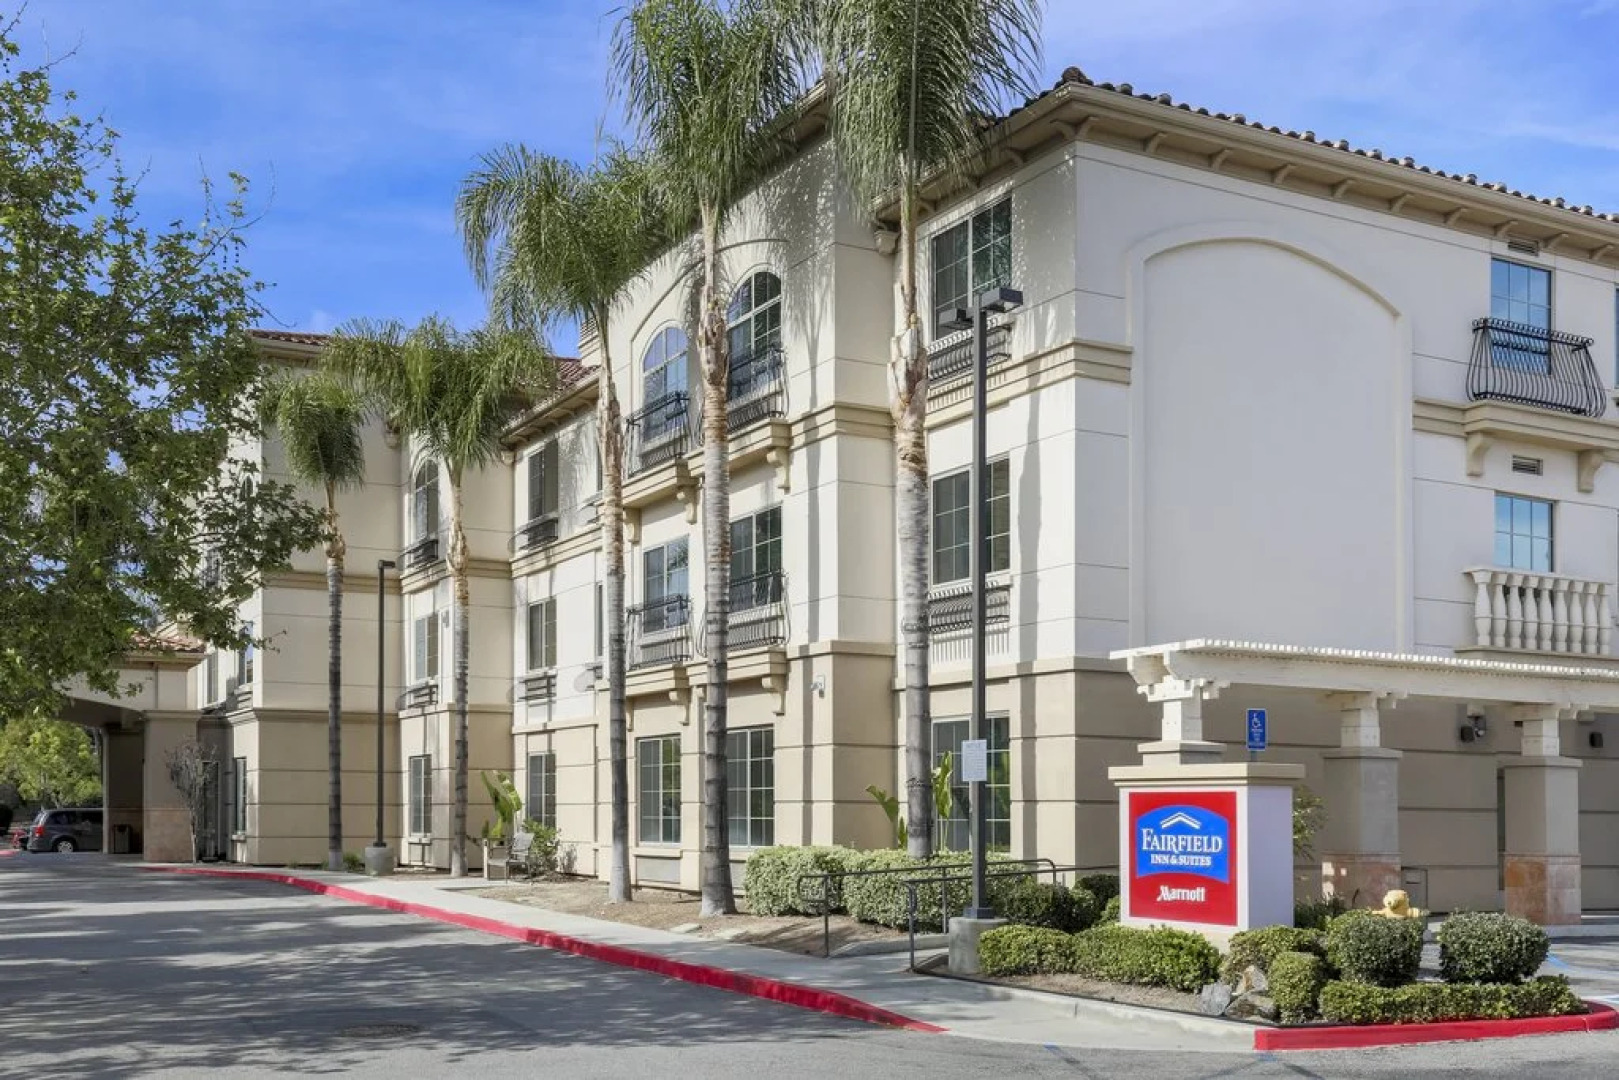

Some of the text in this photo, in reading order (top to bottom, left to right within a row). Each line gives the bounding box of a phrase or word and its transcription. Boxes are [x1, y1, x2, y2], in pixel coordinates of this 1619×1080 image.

[1141, 828, 1223, 854] FAIRFIELD
[1151, 854, 1169, 864] INN
[1178, 855, 1212, 866] SUITES
[1157, 885, 1206, 902] Marriott
